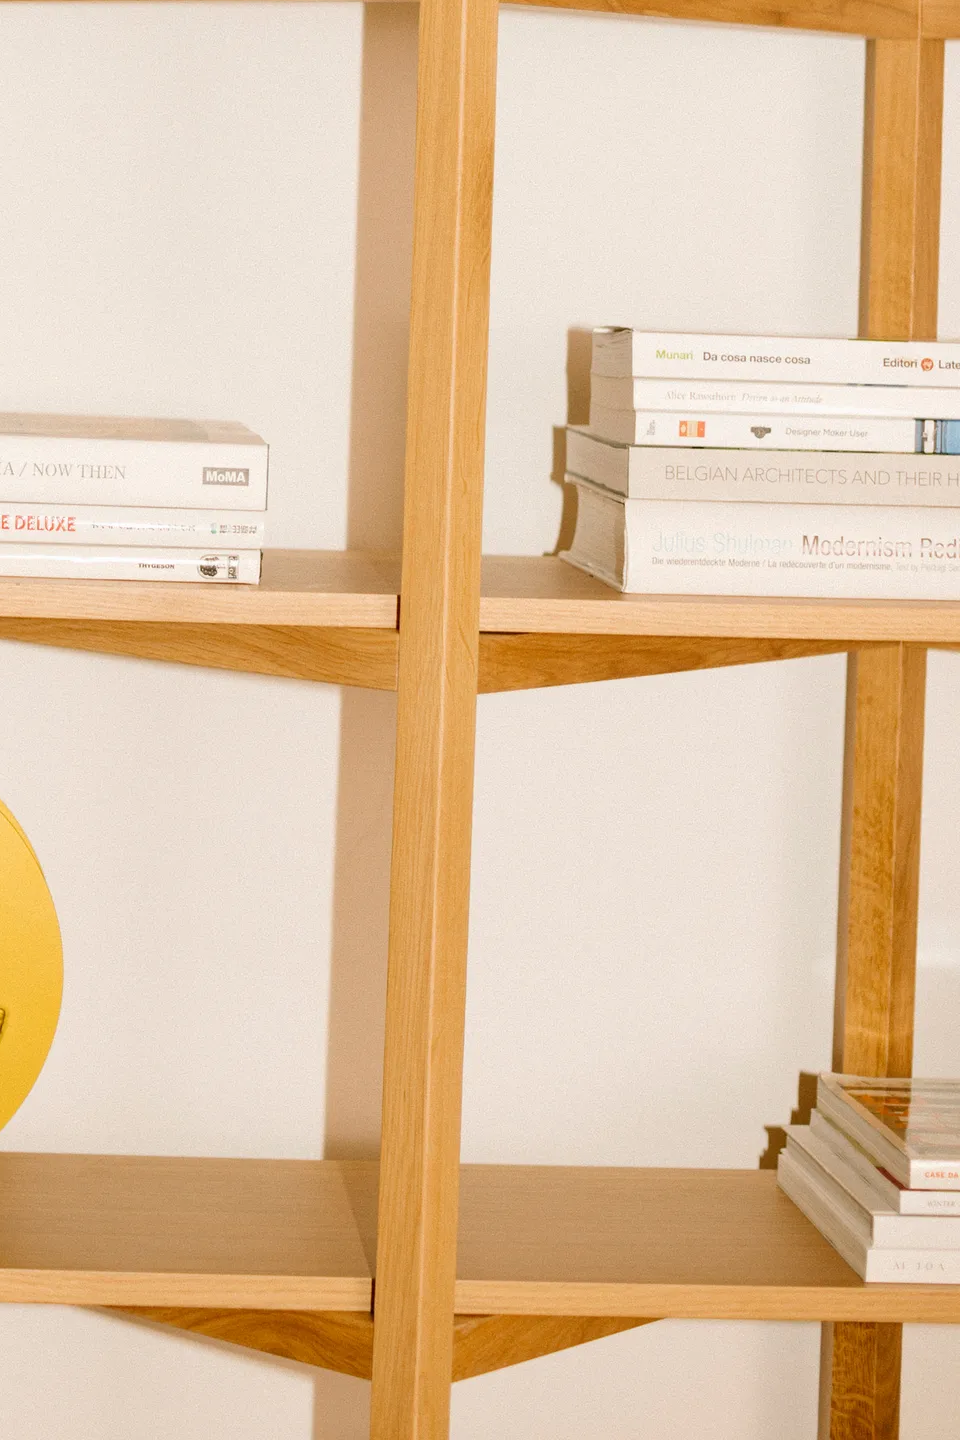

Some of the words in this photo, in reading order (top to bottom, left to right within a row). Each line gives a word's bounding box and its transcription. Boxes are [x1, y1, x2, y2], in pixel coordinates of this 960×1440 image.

[655, 349, 694, 360] Munari
[702, 351, 718, 362] Da
[720, 353, 747, 363] cosa
[749, 355, 782, 364] nasce
[784, 356, 811, 365] cosa
[882, 357, 918, 368] Editori
[664, 389, 687, 400] Alice
[785, 427, 820, 438] Designer
[823, 428, 847, 437] Maker
[849, 429, 869, 438] User
[32, 463, 73, 477] NOW
[77, 464, 127, 480] THEN
[205, 469, 246, 484] MoMA
[664, 465, 738, 482] BELGIAN
[742, 467, 848, 485] ARCHITECTS
[851, 470, 891, 485] AND
[896, 471, 942, 487] THEIR
[14, 514, 77, 532] DELUXE
[652, 531, 705, 553] Julius
[713, 533, 793, 555] Shulman
[802, 535, 912, 558] Modernism
[651, 557, 664, 565] Die
[666, 557, 726, 566] wiederentdeckte
[728, 558, 760, 567] Moderne
[768, 560, 777, 568] La
[924, 1171, 945, 1179] CASE
